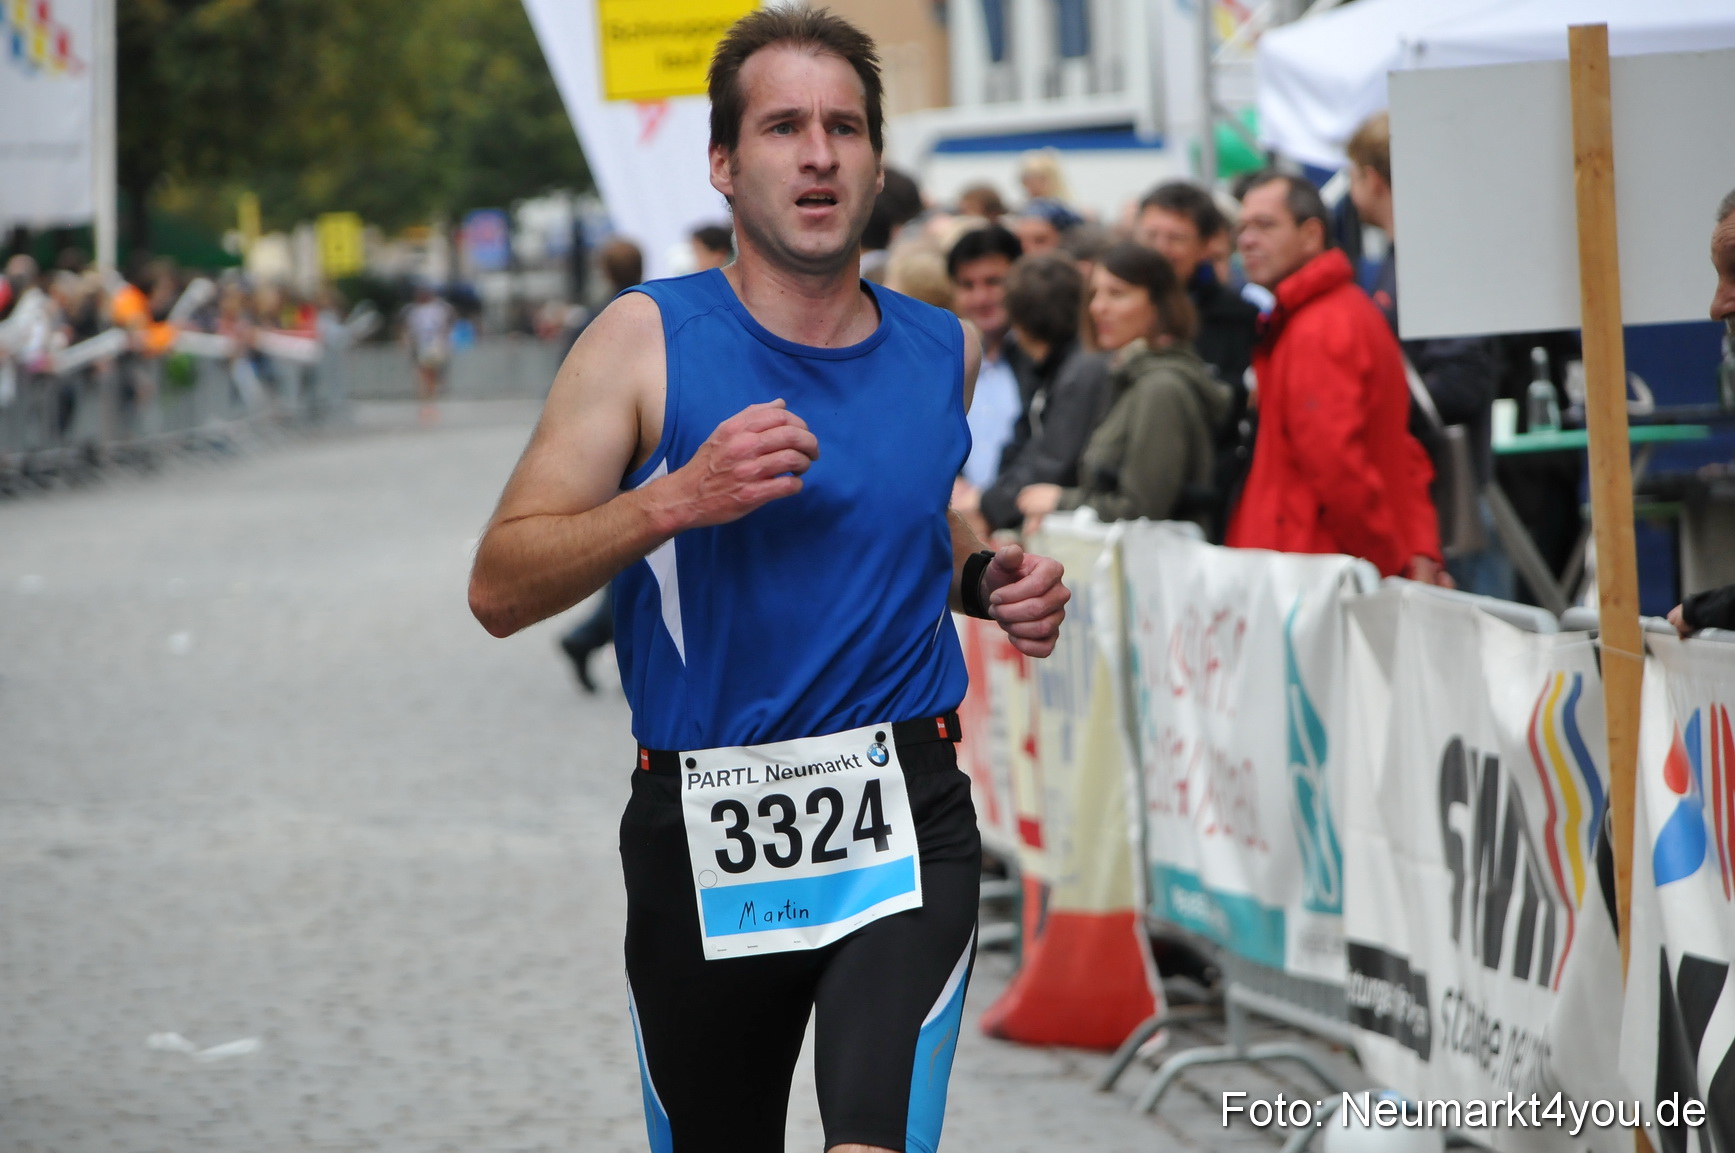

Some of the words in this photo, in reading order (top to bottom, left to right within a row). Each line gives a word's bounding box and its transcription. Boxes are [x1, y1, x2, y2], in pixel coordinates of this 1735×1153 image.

[687, 766, 759, 790] PARTL
[765, 753, 863, 783] Neumarkt
[710, 778, 893, 874] 3324
[738, 899, 810, 930] Martin
